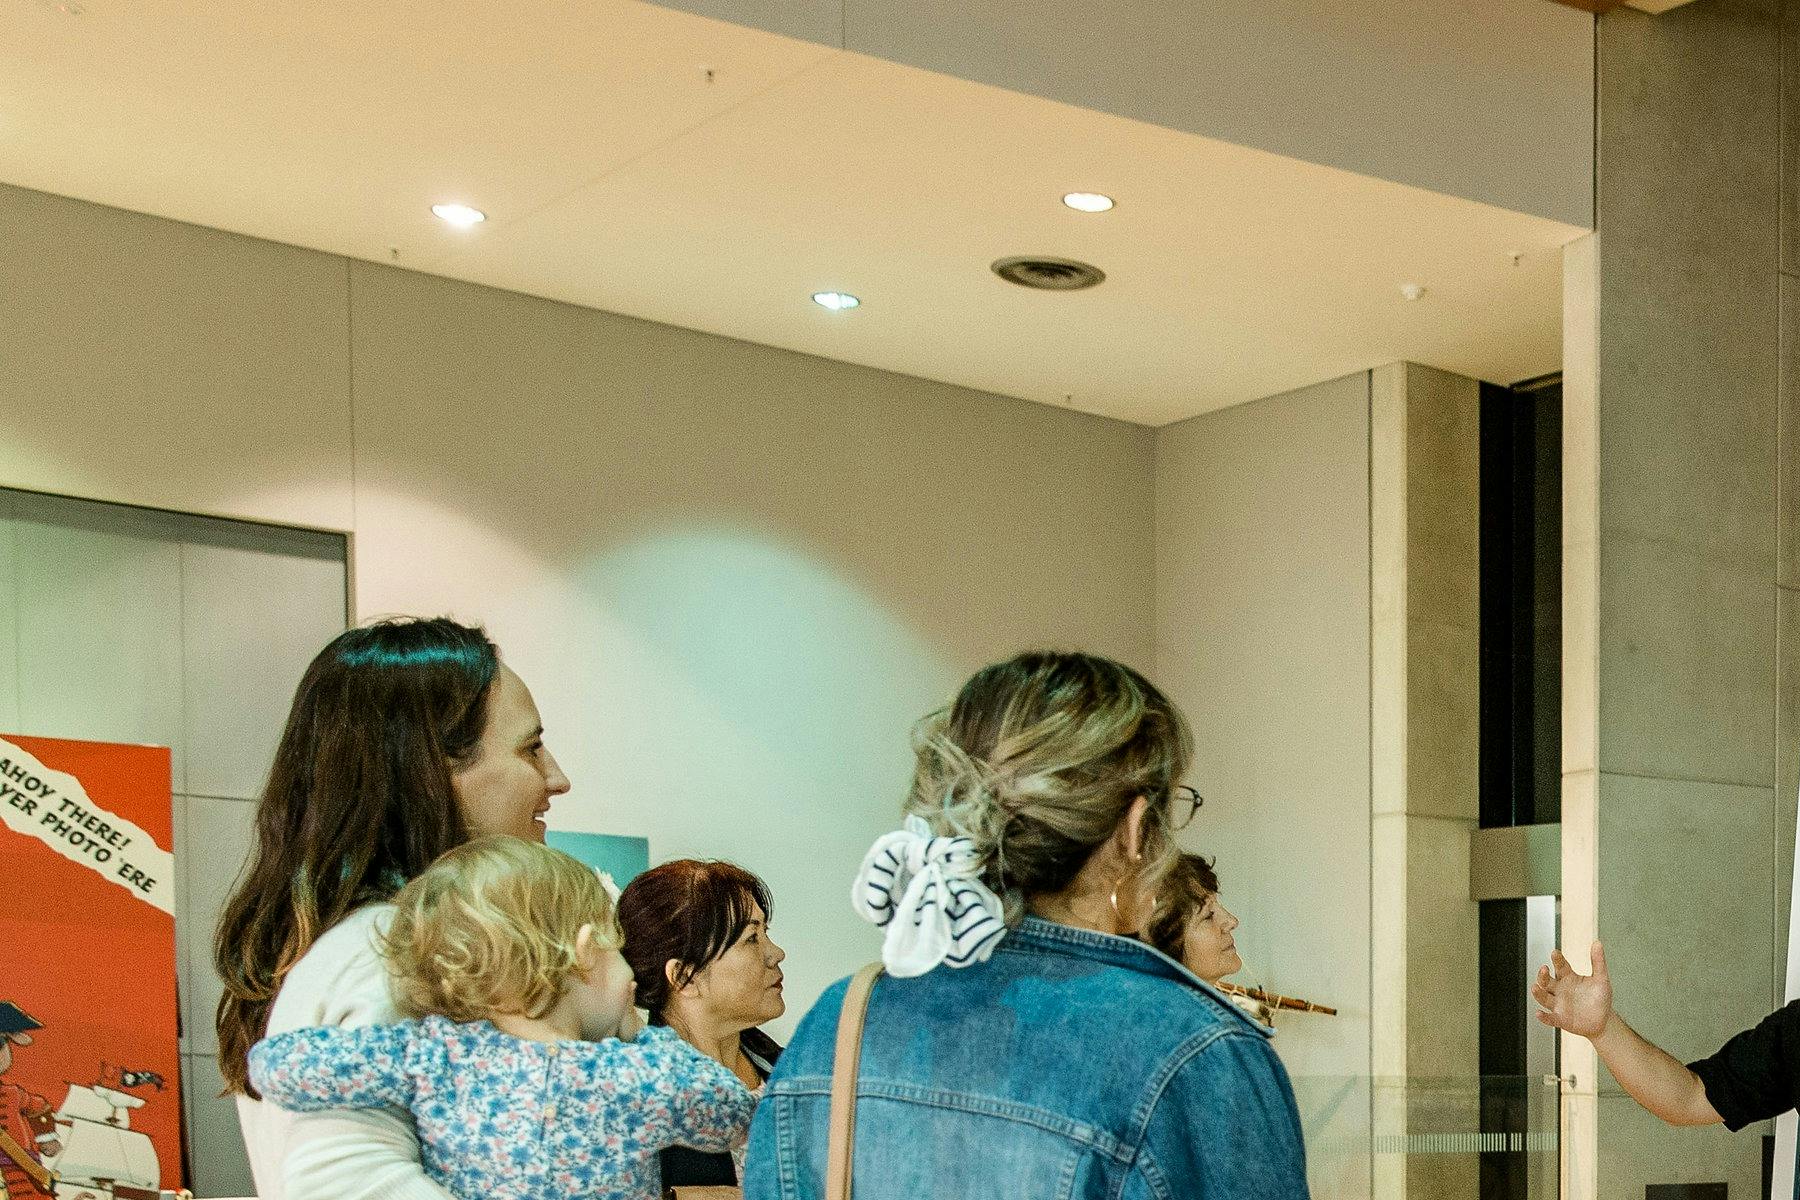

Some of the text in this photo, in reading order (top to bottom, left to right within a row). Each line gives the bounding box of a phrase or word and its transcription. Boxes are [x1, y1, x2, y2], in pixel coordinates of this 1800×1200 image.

[0, 758, 132, 851] AHOY THERE!
[0, 783, 38, 816] YER
[40, 812, 112, 863] PHOTO
